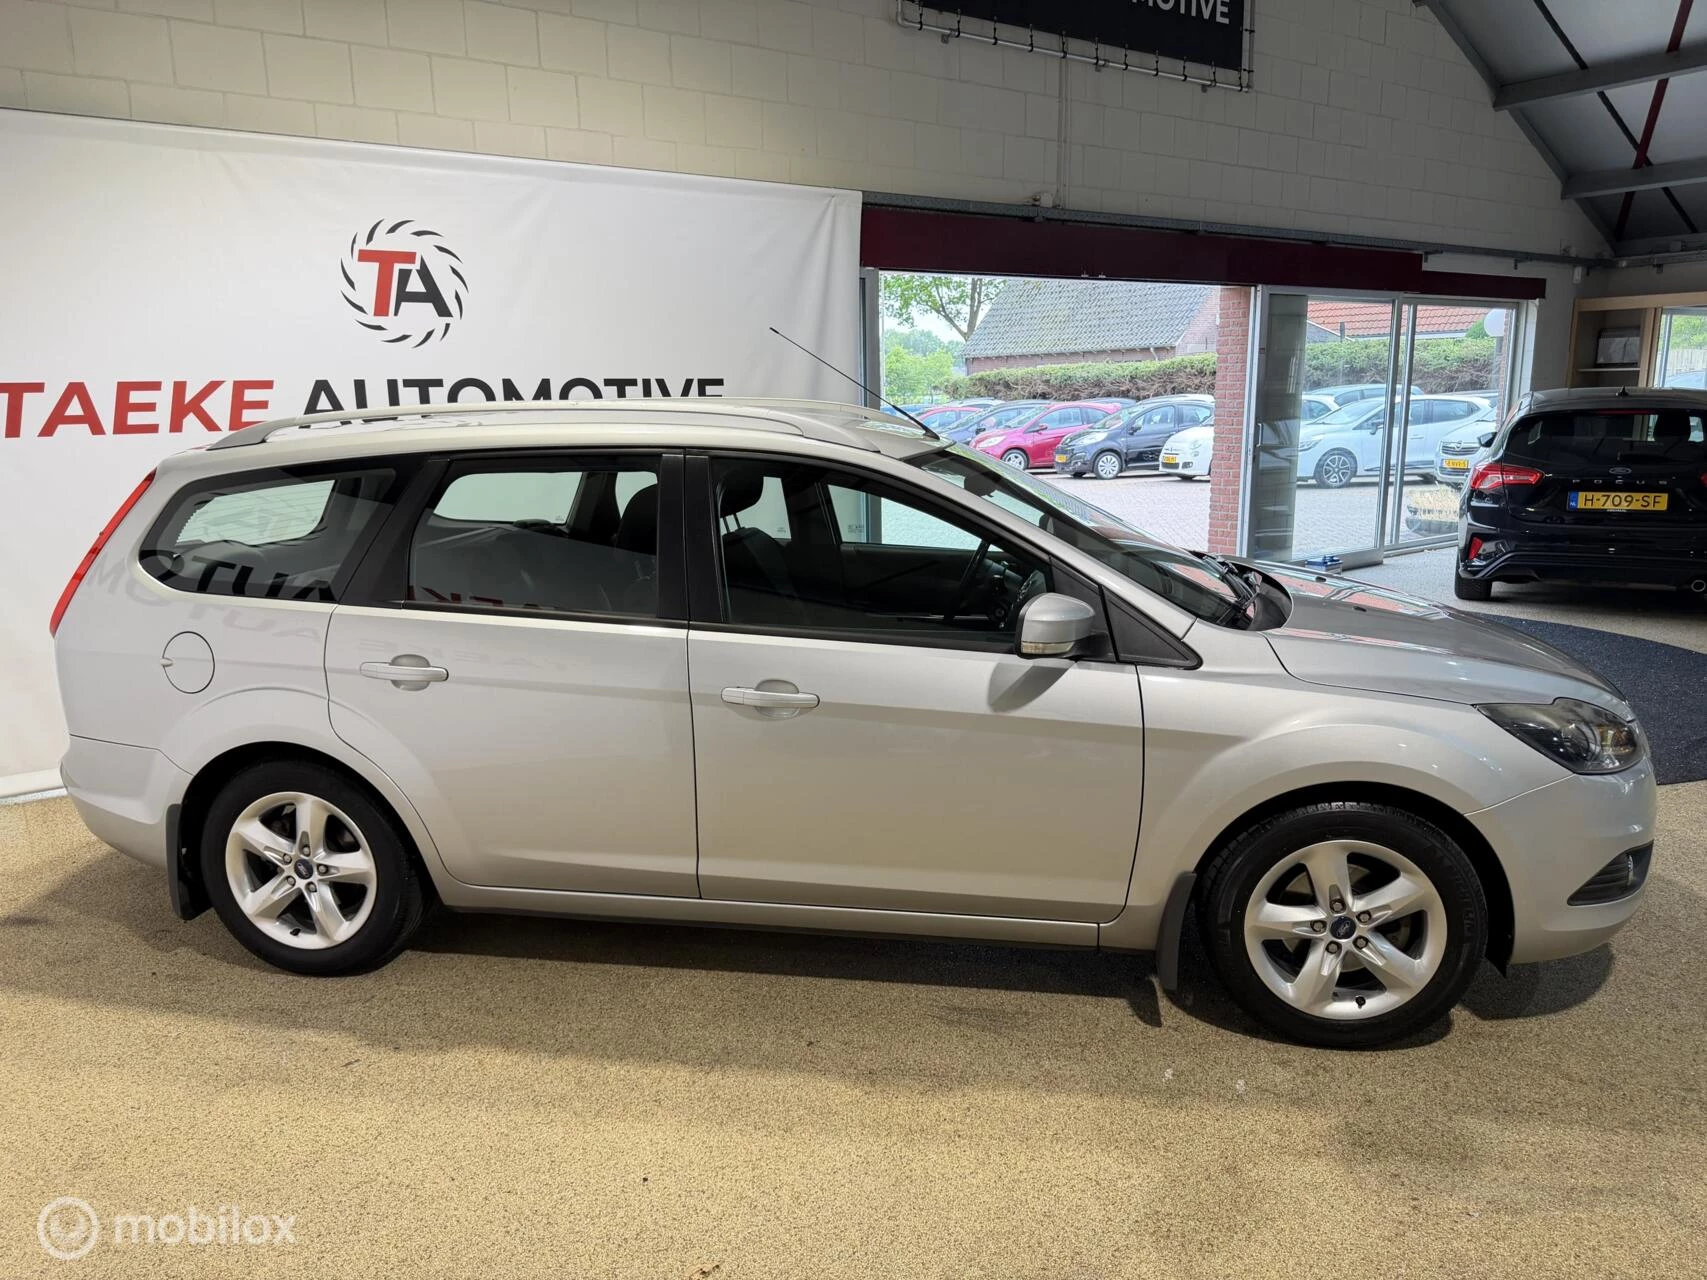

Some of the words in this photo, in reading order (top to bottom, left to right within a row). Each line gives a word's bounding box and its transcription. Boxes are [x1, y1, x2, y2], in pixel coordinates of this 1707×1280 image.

[1131, 0, 1230, 24] TIVE
[358, 249, 453, 317] TA
[0, 380, 274, 438] TAEKE
[1583, 493, 1662, 508] H-709-SF
